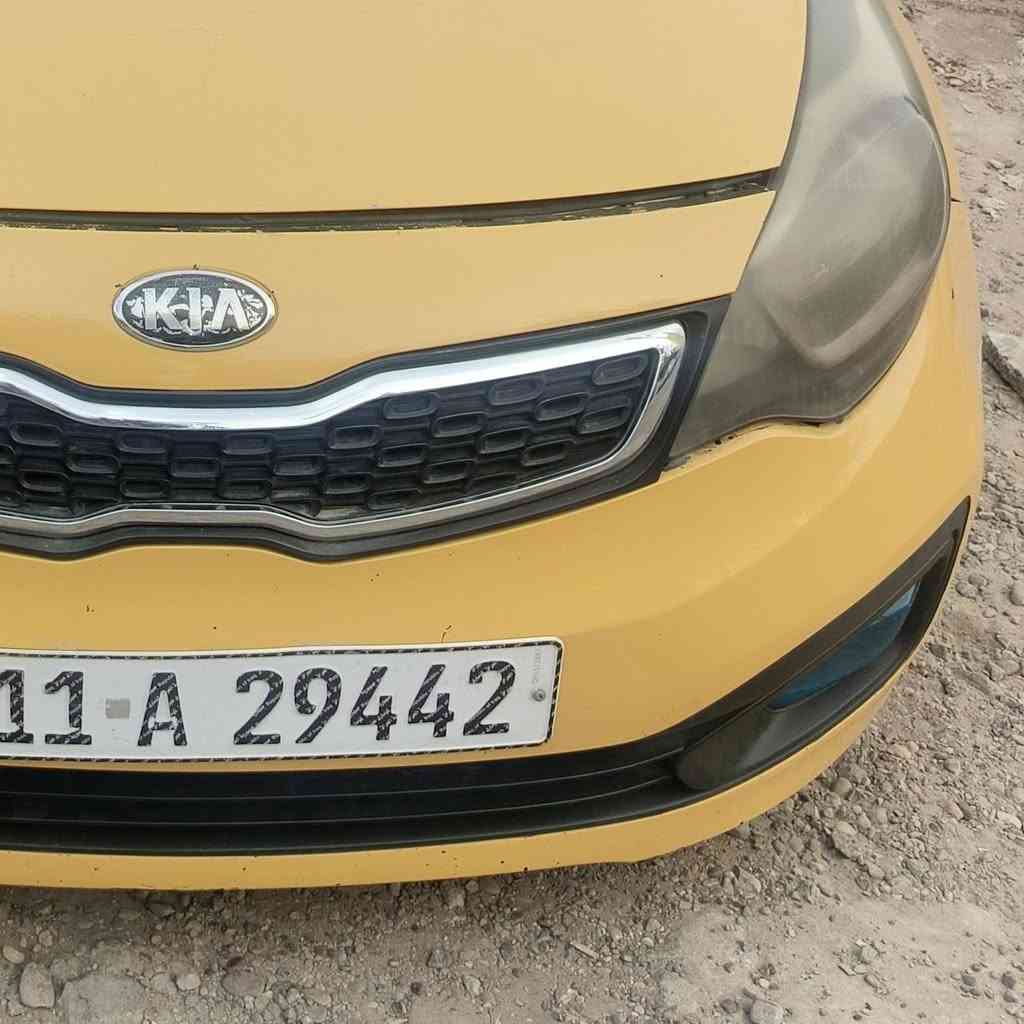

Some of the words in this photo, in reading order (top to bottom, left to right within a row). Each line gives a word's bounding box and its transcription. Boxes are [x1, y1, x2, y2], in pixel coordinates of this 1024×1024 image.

[142, 287, 250, 332] KIA
[137, 672, 188, 747] A
[233, 661, 518, 745] 29442
